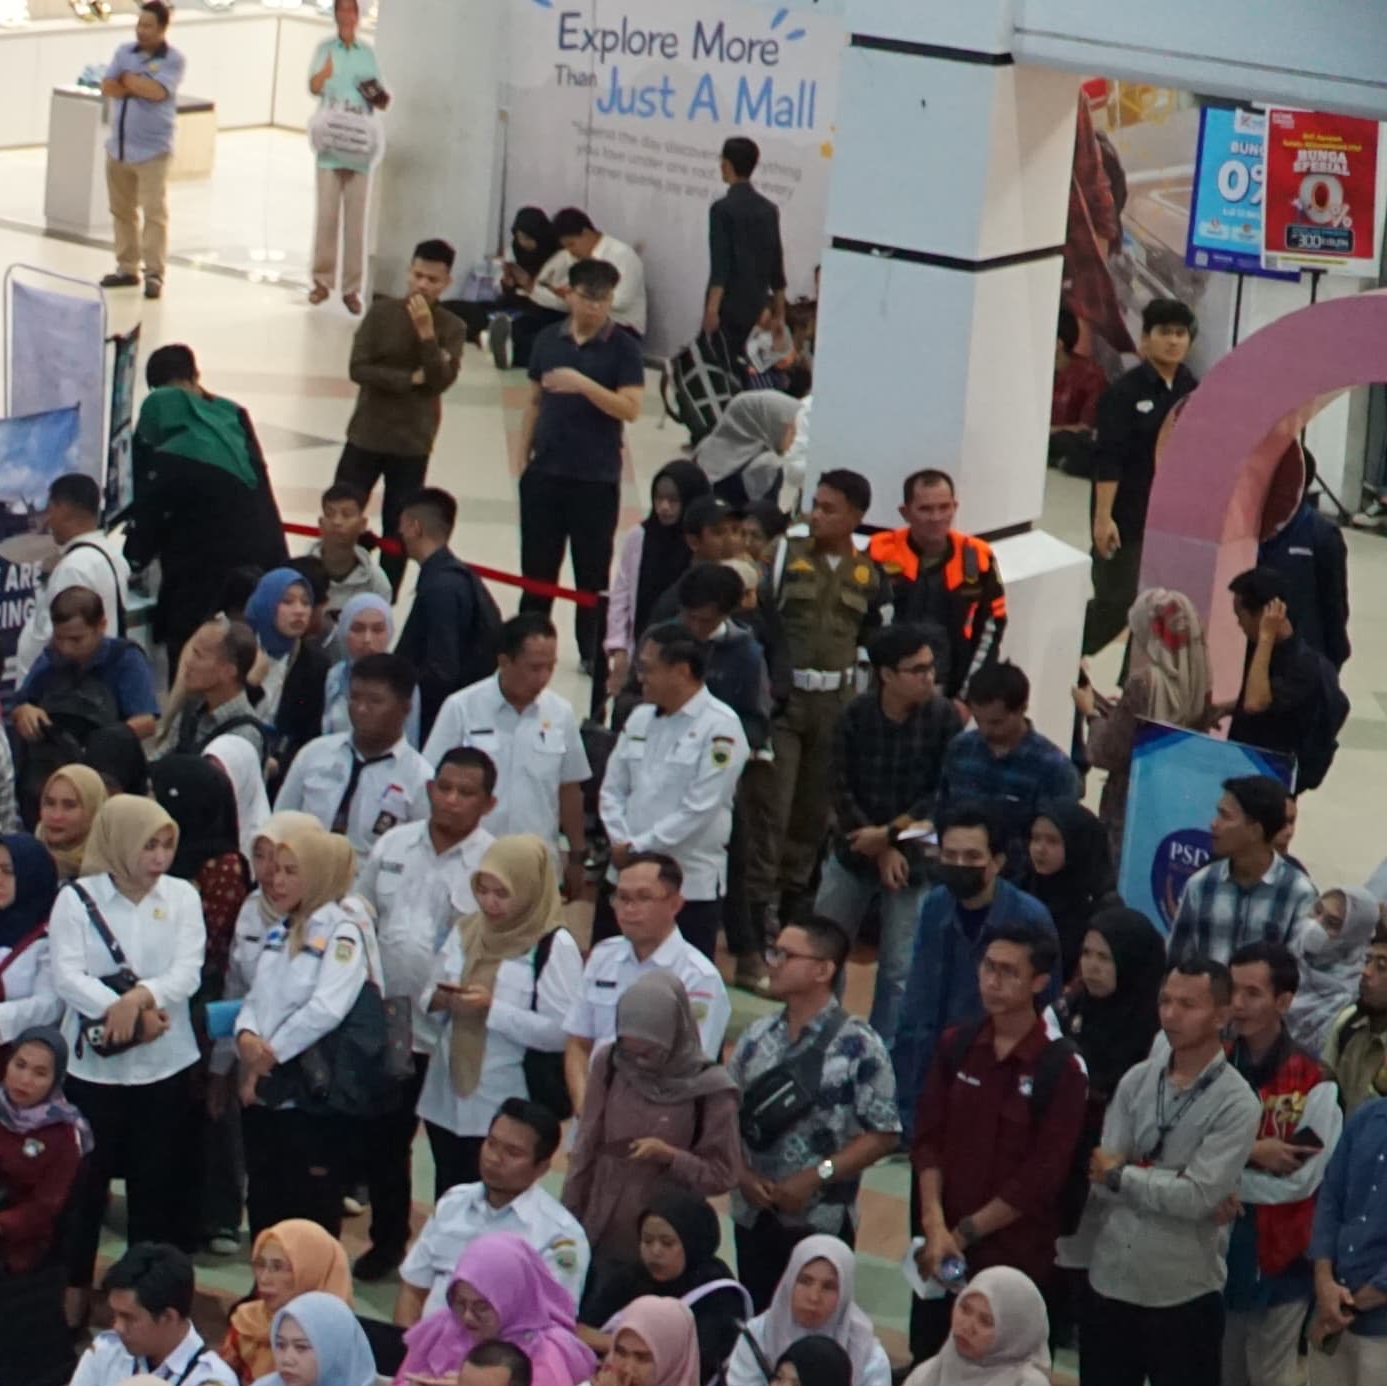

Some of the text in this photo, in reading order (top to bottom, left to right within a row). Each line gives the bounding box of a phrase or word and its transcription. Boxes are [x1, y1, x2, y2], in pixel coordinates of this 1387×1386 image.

[558, 11, 779, 66] Explore More
[555, 64, 816, 129] Than Just A Mall
